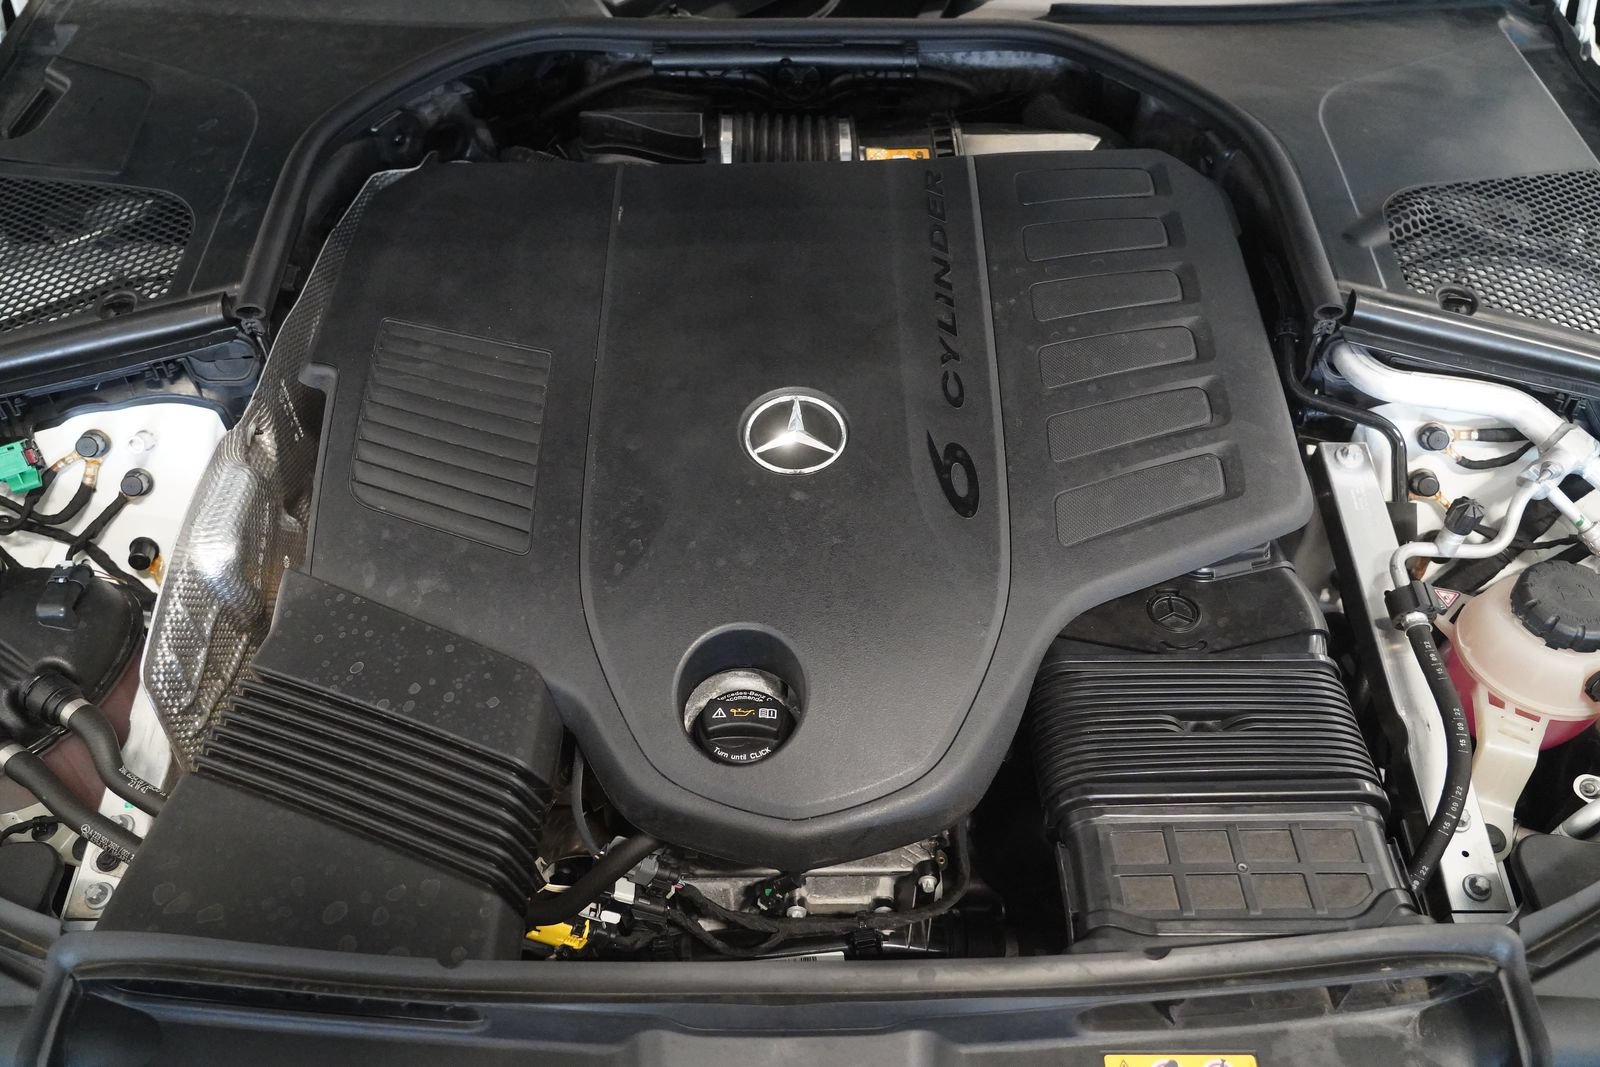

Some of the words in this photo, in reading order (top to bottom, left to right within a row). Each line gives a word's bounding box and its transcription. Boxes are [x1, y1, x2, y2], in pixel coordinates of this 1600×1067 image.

[925, 169, 965, 409] CYLINDER
[927, 429, 980, 519] 6
[713, 746, 729, 758] Turn
[749, 746, 772, 759] CLICK
[1442, 821, 1451, 831] 15
[1451, 801, 1459, 812] 09
[1455, 785, 1464, 796] 22
[1420, 865, 1429, 876] 22
